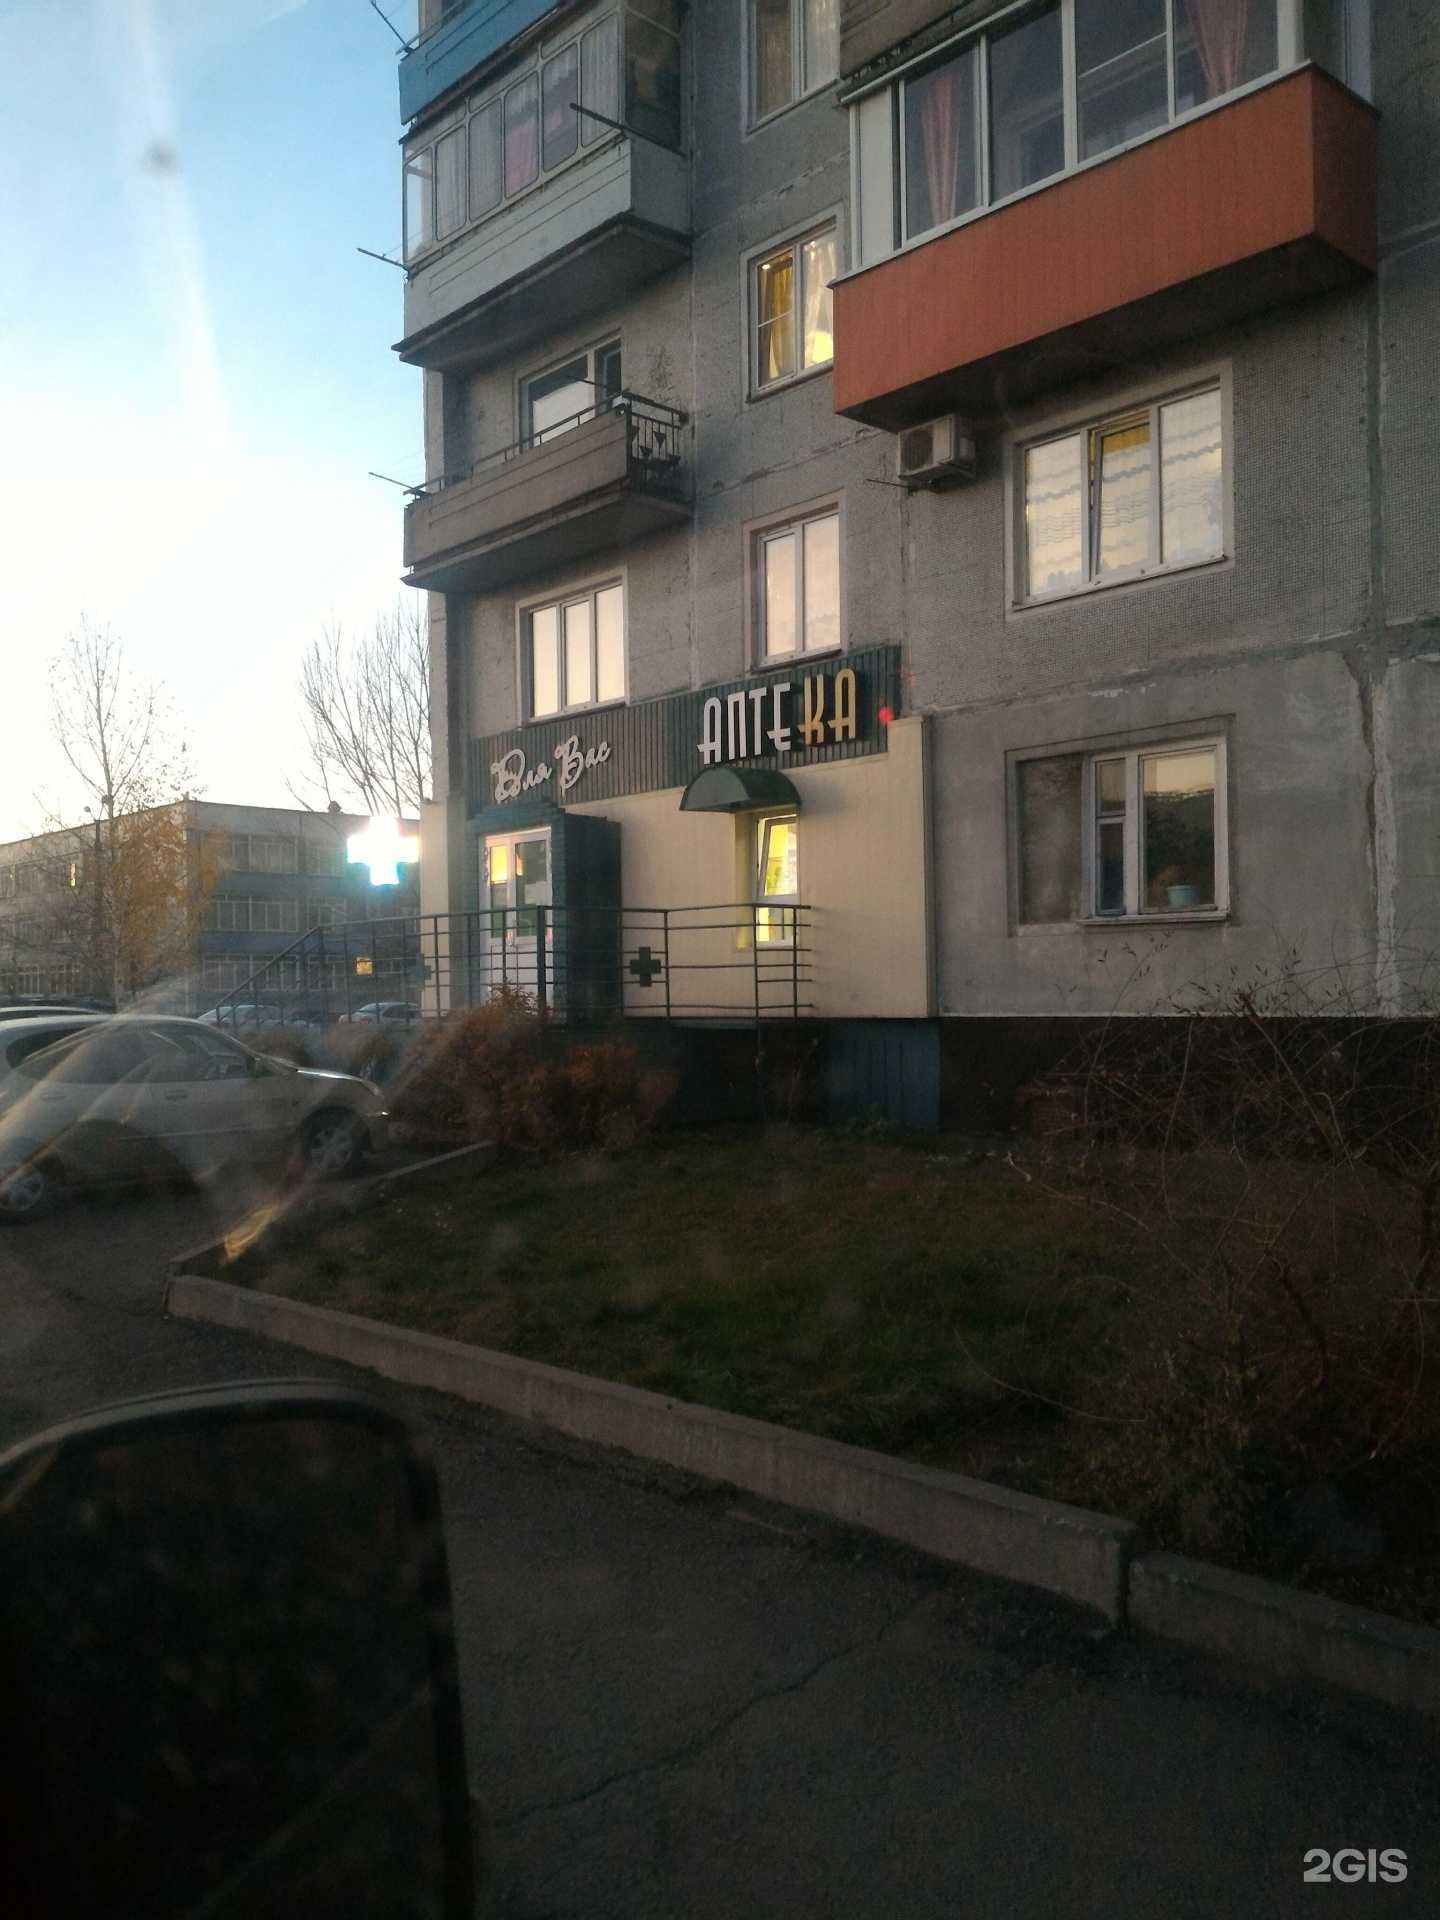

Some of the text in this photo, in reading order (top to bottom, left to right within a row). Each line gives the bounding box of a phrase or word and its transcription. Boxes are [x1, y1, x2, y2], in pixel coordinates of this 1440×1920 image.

[696, 668, 856, 764] АПТЕКА
[490, 735, 611, 803] Для Вас
